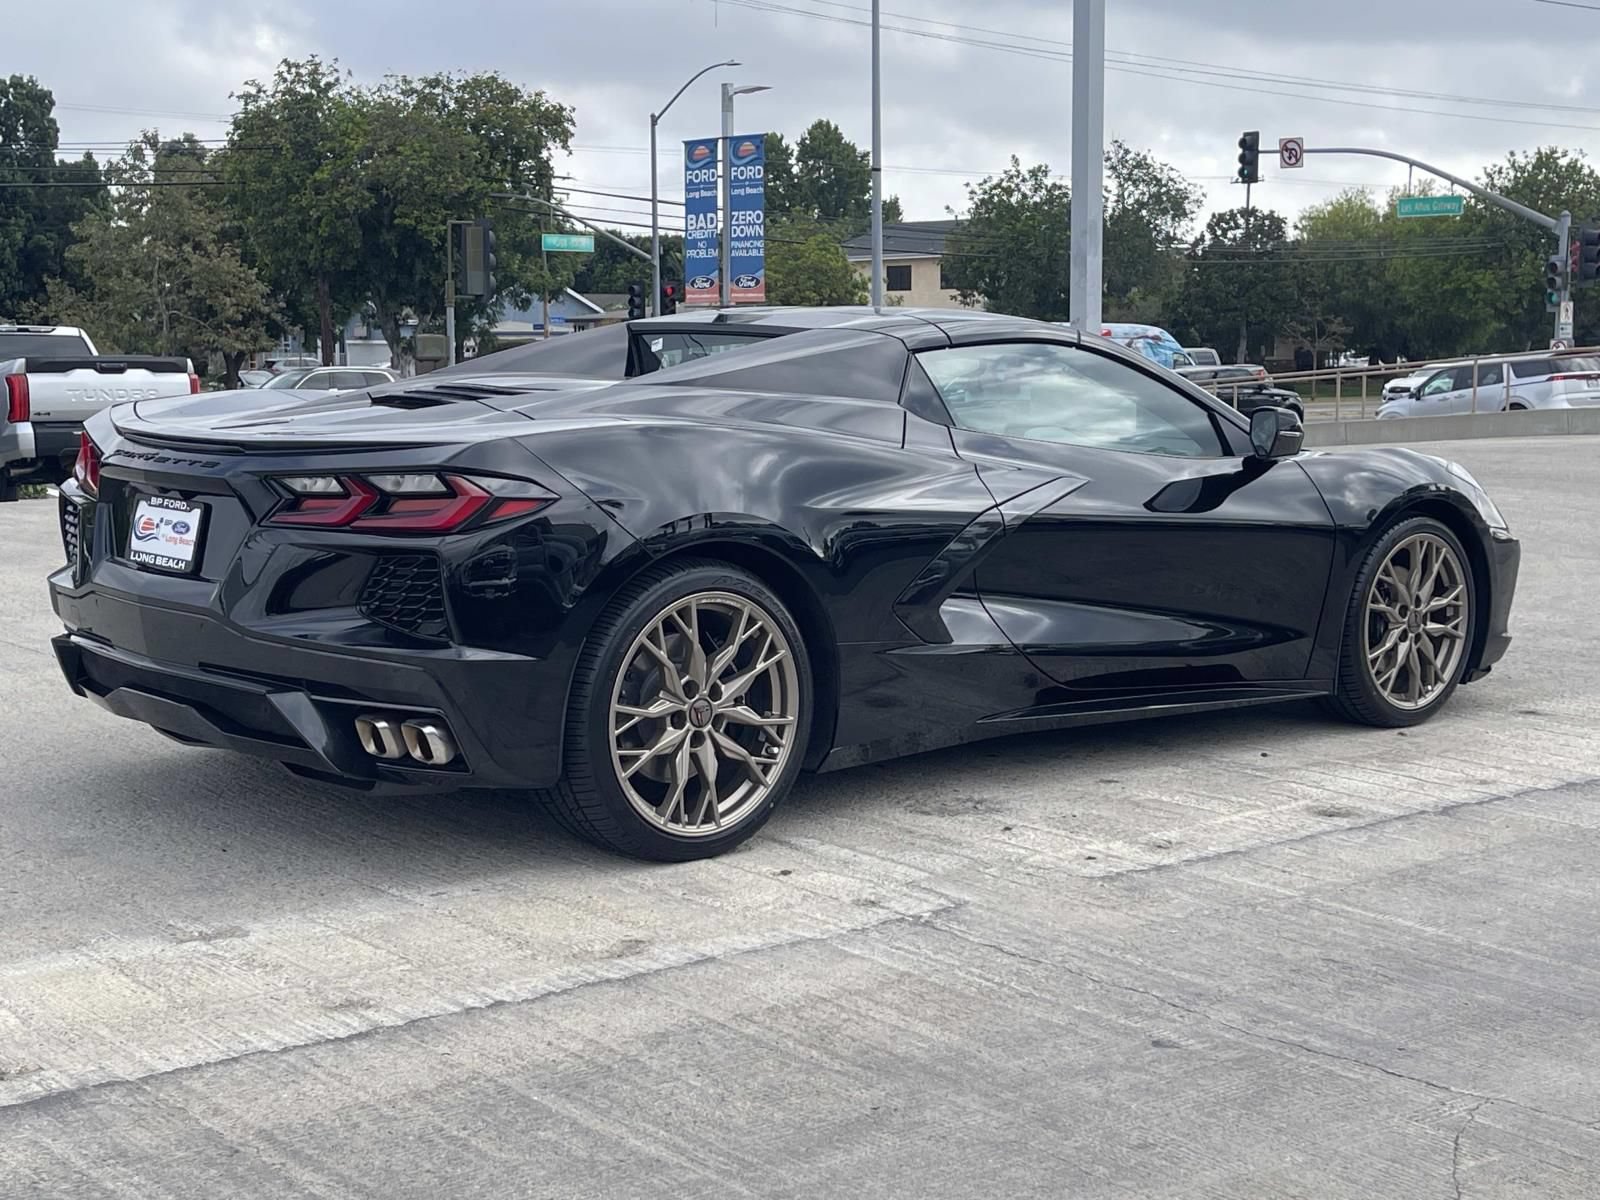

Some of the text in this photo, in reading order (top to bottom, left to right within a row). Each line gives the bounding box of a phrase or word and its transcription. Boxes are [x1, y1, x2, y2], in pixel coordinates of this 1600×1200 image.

[686, 169, 717, 184] FORD
[731, 165, 764, 180] FORD
[686, 189, 717, 199] Long Beach
[731, 186, 764, 196] Long Beach
[687, 213, 717, 230] BAD
[731, 210, 764, 225] ZERO
[731, 224, 764, 238] DOWN
[697, 241, 708, 249] NO
[731, 240, 764, 249] FINANCING
[686, 248, 718, 259] PROBLEM
[731, 248, 765, 257] AVAILABLE
[692, 277, 712, 288] Ford
[737, 276, 758, 288] Ford
[150, 496, 187, 510] BP FORD
[130, 551, 186, 570] LONG BEACH
